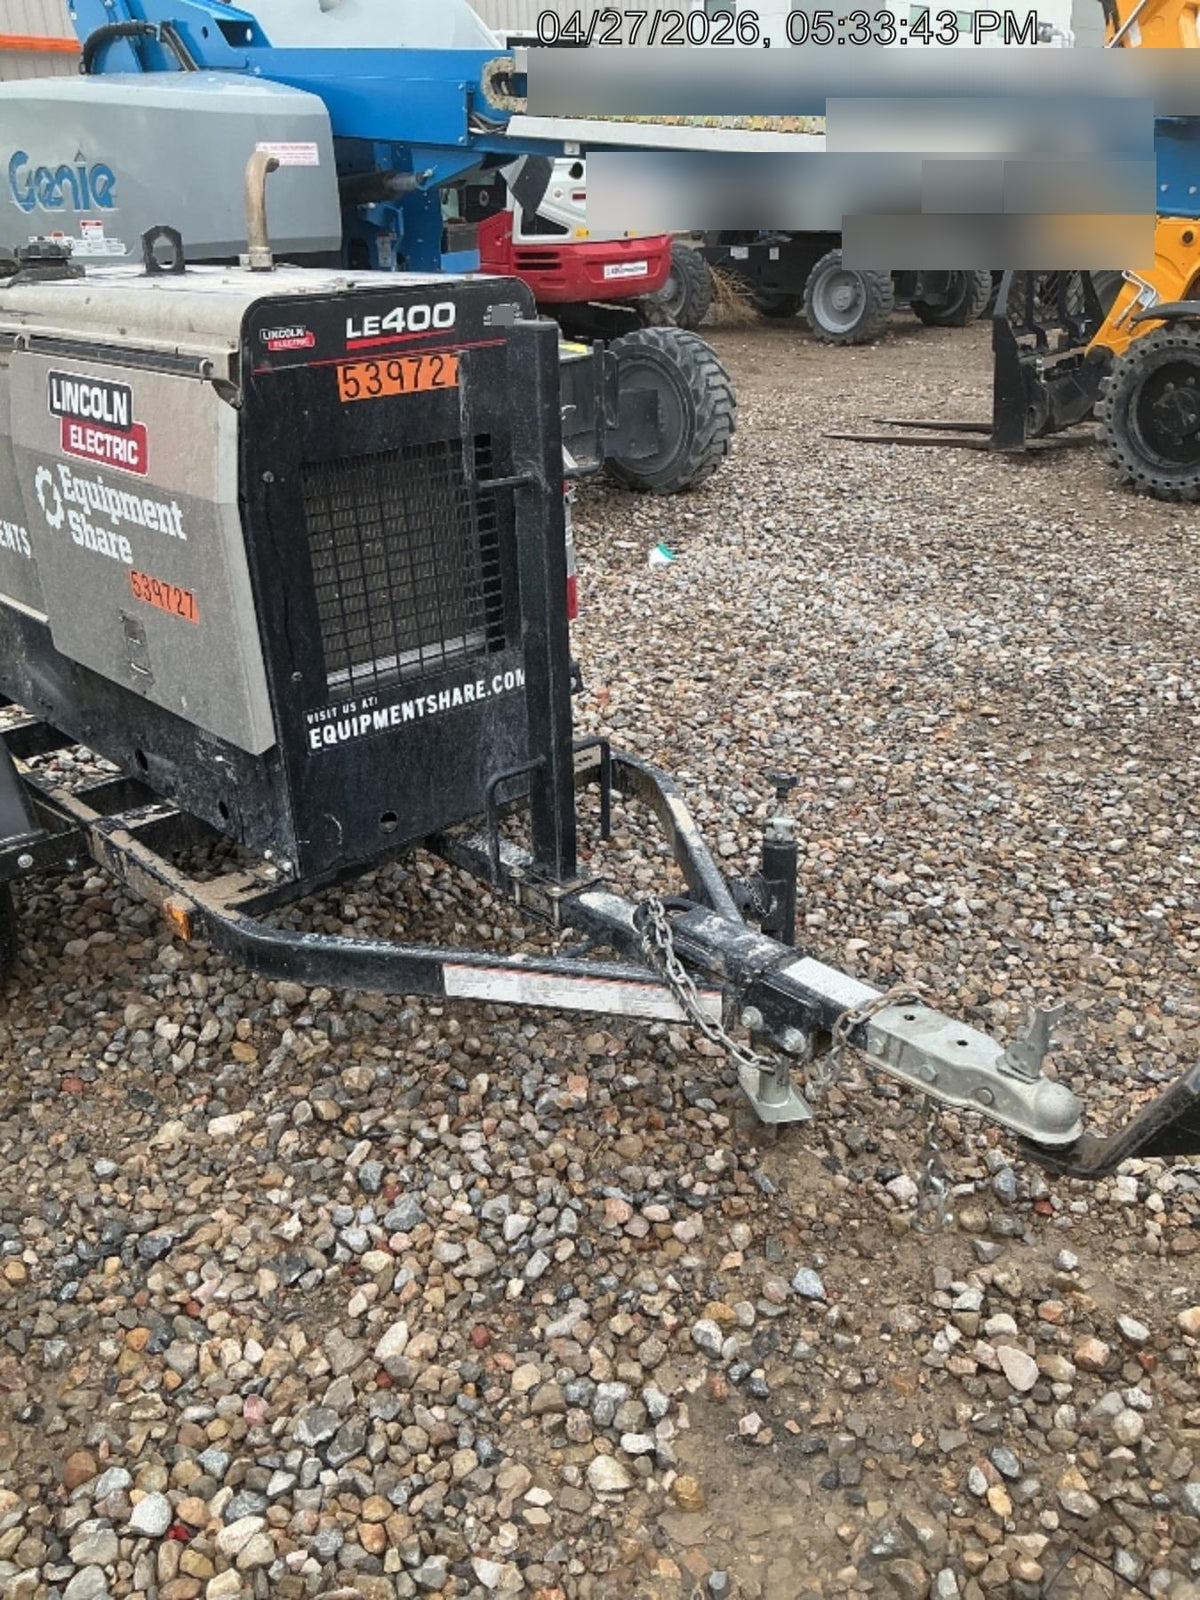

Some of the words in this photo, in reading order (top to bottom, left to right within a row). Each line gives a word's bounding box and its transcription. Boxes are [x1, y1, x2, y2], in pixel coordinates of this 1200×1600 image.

[8, 150, 118, 214] Genie
[261, 327, 305, 341] LINCOLN
[346, 302, 456, 339] LE400
[51, 377, 129, 427] LINCOLN
[69, 424, 139, 465] ELECTRIC
[56, 463, 188, 541] Equipment
[67, 510, 134, 564] Share
[130, 570, 194, 619] 539727
[306, 706, 338, 725] VISIT
[342, 701, 357, 714] US
